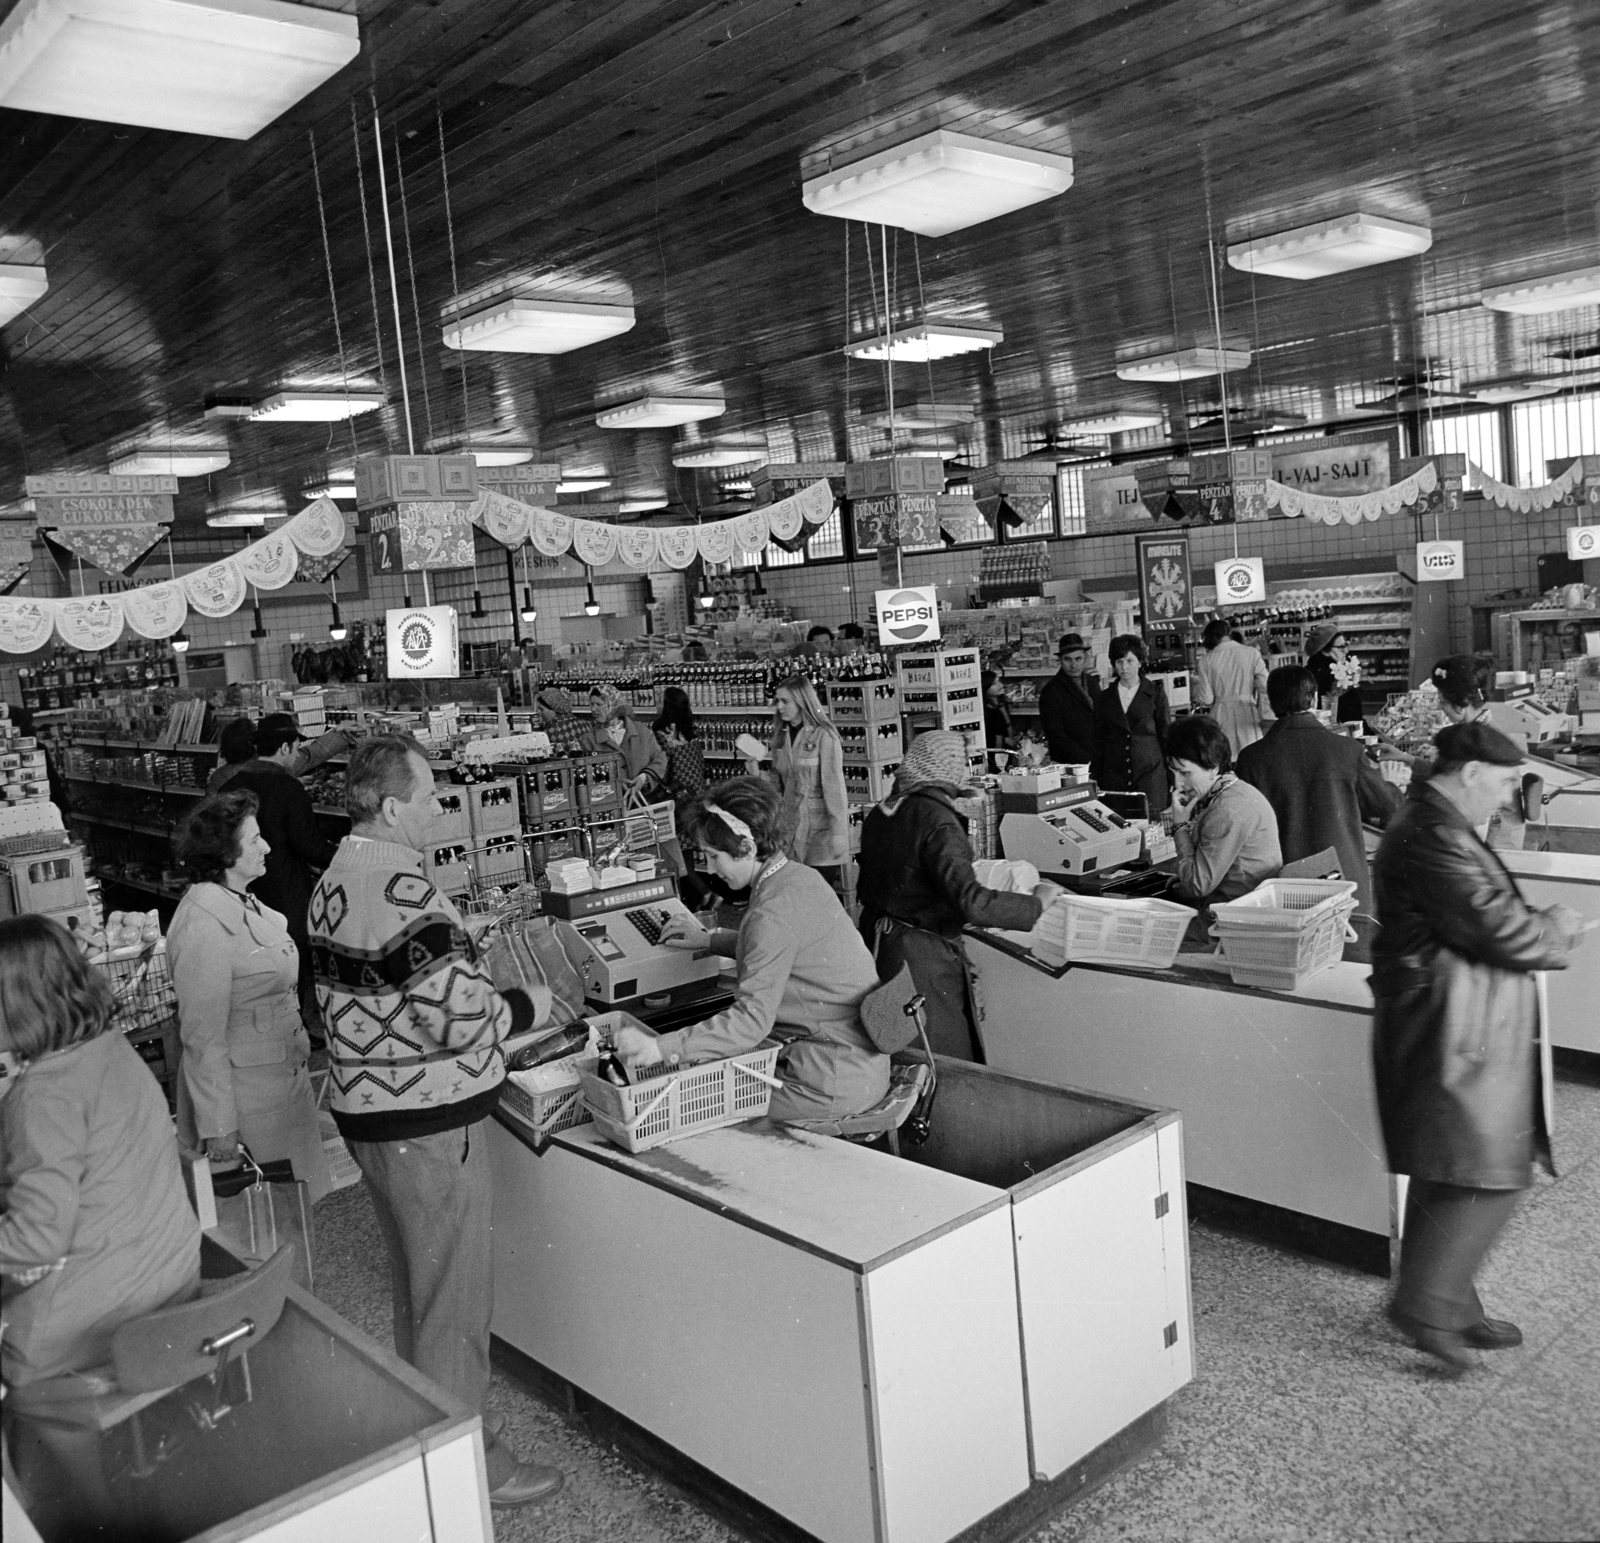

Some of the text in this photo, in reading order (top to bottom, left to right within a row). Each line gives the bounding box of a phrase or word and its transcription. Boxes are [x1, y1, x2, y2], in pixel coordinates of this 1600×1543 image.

[1116, 488, 1139, 505] TEJ
[1200, 482, 1232, 500] PÉNZTÁR
[857, 496, 897, 517] PÉNZTÁR
[901, 494, 938, 513] PÉNZTÁR
[1147, 544, 1182, 558] MIRELITE
[398, 612, 436, 630] MARGITSZIGETI
[882, 606, 933, 624] PEPSI
[834, 707, 862, 715] PEPSI
